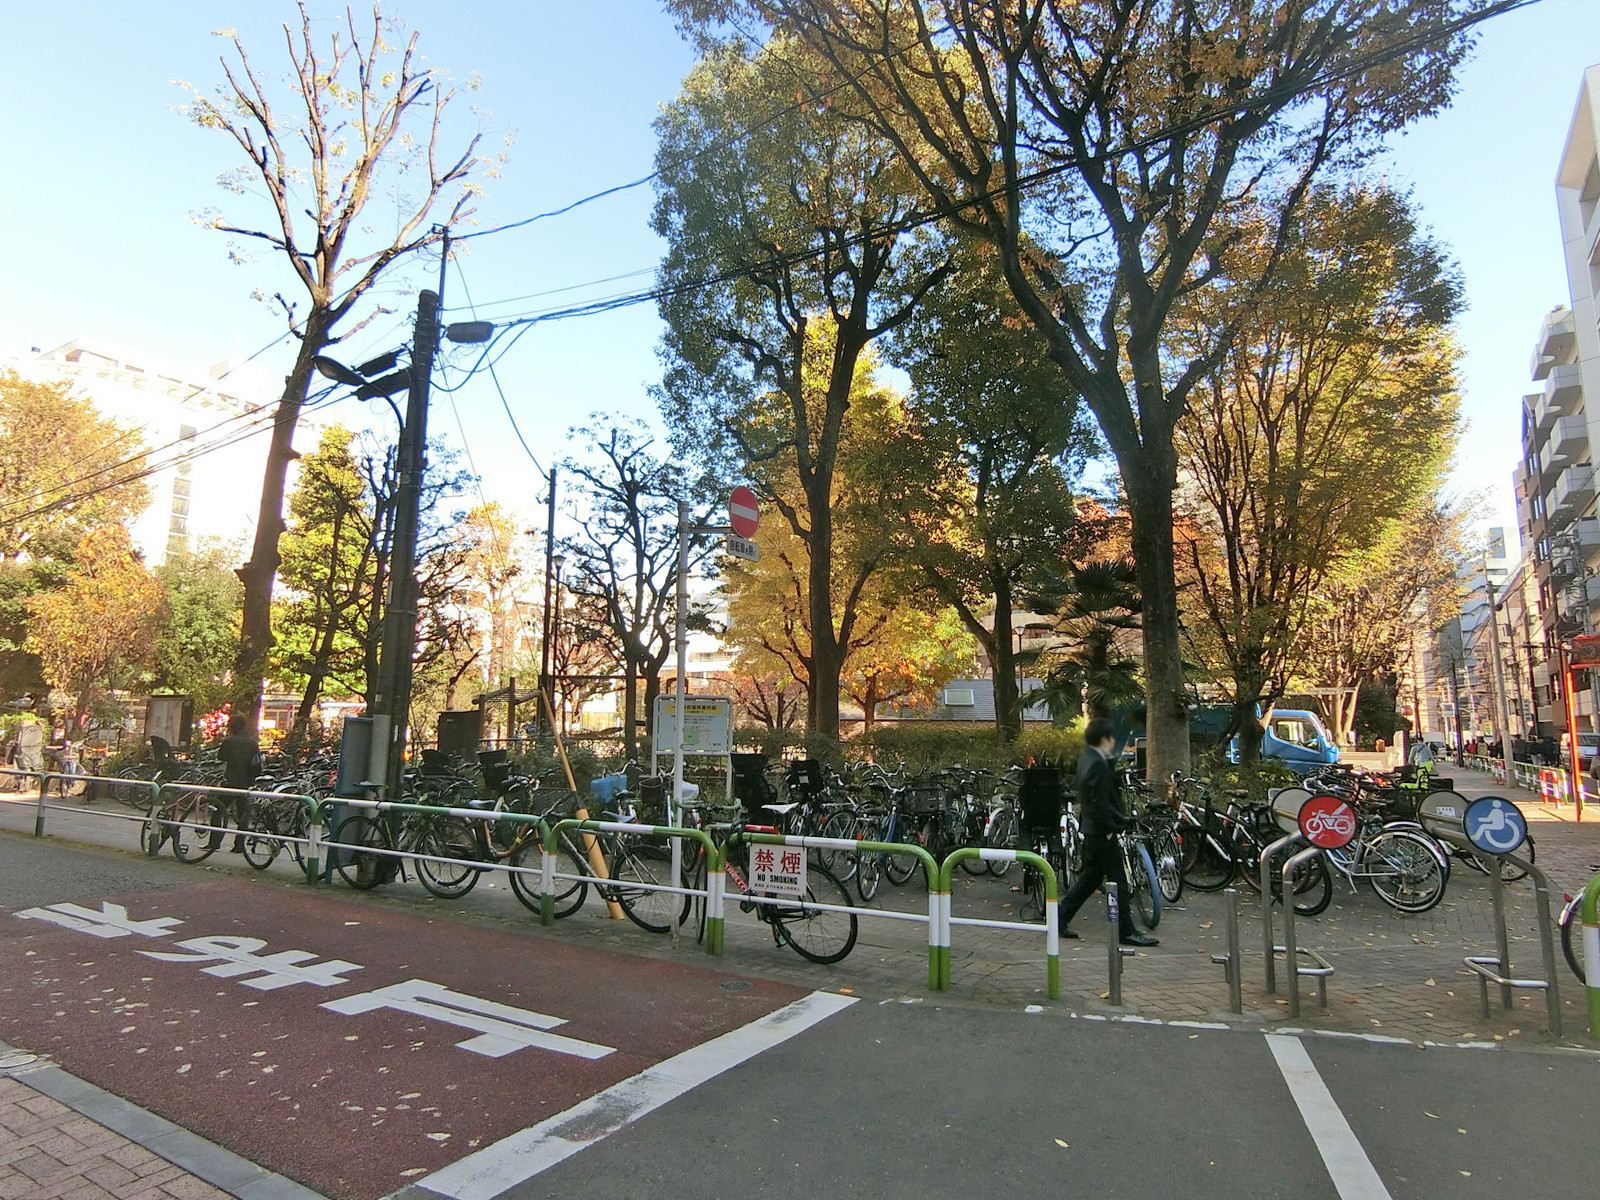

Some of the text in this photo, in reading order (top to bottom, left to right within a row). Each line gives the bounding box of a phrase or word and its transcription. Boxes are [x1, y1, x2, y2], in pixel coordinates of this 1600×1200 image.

[754, 848, 801, 875] 禁煙
[757, 873, 766, 882] NO
[769, 874, 798, 885] SMOKING
